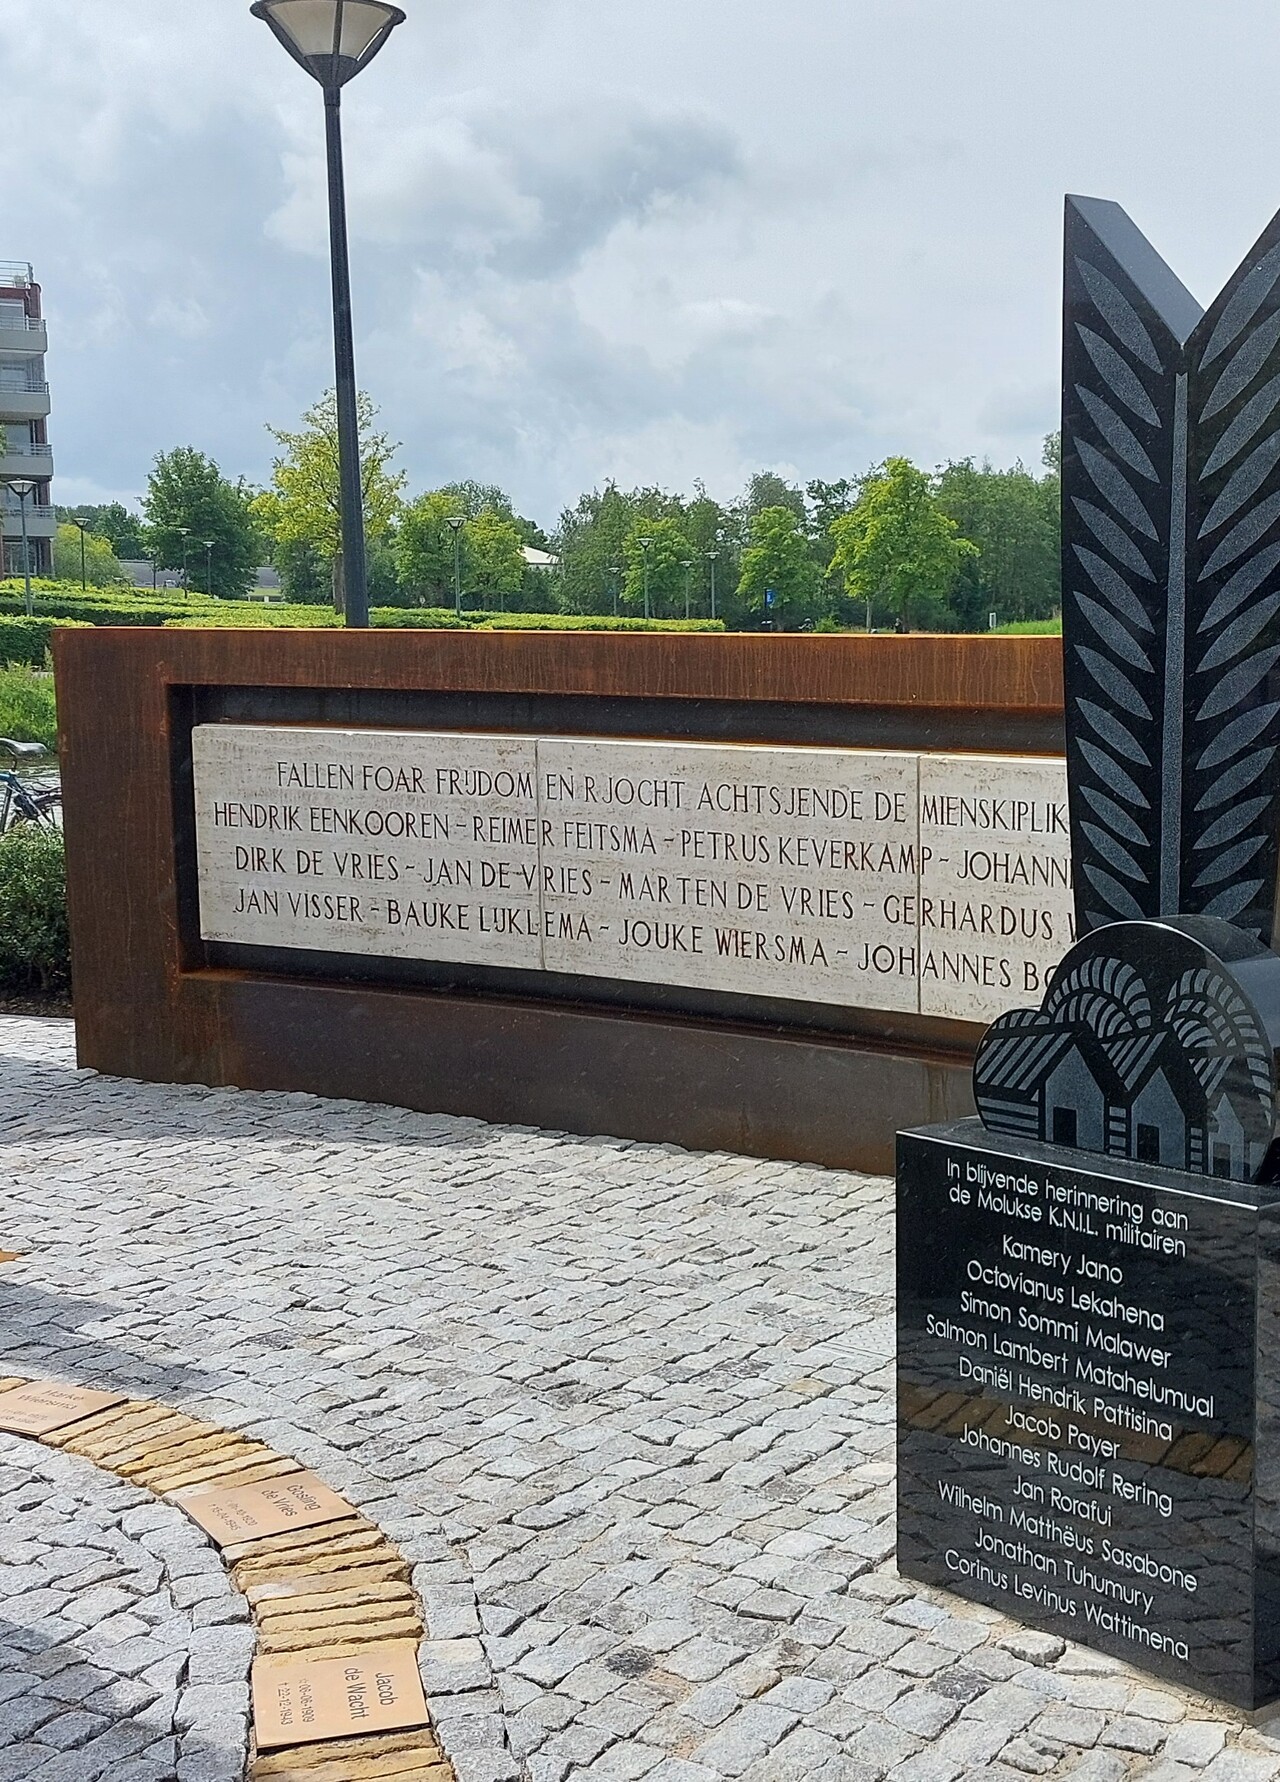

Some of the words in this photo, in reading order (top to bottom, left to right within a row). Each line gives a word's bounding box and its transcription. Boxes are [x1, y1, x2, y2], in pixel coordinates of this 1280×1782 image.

[277, 761, 353, 789] FALLEN
[362, 765, 426, 794] FOAR
[546, 773, 574, 800] EN
[697, 783, 863, 820] ACHTSJENDE
[875, 792, 906, 823] DE
[214, 802, 303, 831] HENDRIK
[310, 807, 449, 840] EENKOOREN
[473, 816, 555, 847] REIMER
[564, 822, 657, 854] FEITSMA
[681, 829, 770, 863] PETRUS
[779, 836, 932, 875] KEVERKAMP
[957, 850, 1073, 889] JOHANN
[235, 845, 288, 873] DIRK
[297, 850, 324, 876] DE
[333, 852, 399, 881] VRIES
[423, 858, 471, 885] JAN
[481, 860, 510, 889] DE
[521, 864, 593, 896] VRIES
[619, 872, 727, 908] MARTEN
[737, 882, 768, 912] DE
[780, 886, 853, 920] VRIES
[884, 894, 1052, 940] GERHARDUS
[235, 888, 279, 917] JAN
[287, 892, 363, 923] VISSER
[387, 900, 470, 931] BAUKE
[619, 919, 703, 953] JOUKE
[714, 928, 829, 967] WIERSMA
[858, 943, 1011, 988] JOHANNES
[947, 1157, 960, 1179] In
[966, 1161, 1039, 1196] blijvende
[1045, 1179, 1144, 1224] herinnering
[1151, 1208, 1189, 1231] aan
[949, 1184, 971, 1205] de
[978, 1193, 1042, 1223] Molukse
[1049, 1205, 1099, 1237] K.N.I.L.
[1106, 1221, 1186, 1258] militairen
[967, 1260, 1064, 1304] Octovianus
[1071, 1285, 1165, 1332] Lekahena
[1003, 1234, 1071, 1275] Kamery
[1076, 1254, 1123, 1284] Jano
[926, 1313, 987, 1351] Salmon
[993, 1332, 1068, 1374] Lambert
[1075, 1357, 1214, 1419] Matahelumual
[960, 1290, 1011, 1324] Simon
[1018, 1307, 1079, 1343] Sommi
[1086, 1325, 1172, 1369] Malawer
[959, 1355, 1013, 1392] Daniël
[1019, 1373, 1087, 1416] Hendrik
[1094, 1397, 1173, 1442] Pattisina
[1004, 1405, 1061, 1440] Jacob
[1068, 1423, 1120, 1460] Payer
[959, 1423, 1040, 1467] Johannes
[1047, 1451, 1105, 1491] Rudolf
[1113, 1473, 1173, 1517] Rering
[1013, 1475, 1044, 1504] Jan
[273, 1498, 298, 1517] Vries
[938, 1480, 1003, 1522] Wilhelm
[1009, 1508, 1094, 1555] Matthëus
[1101, 1539, 1197, 1592] Sasabone
[945, 1549, 1008, 1590] Corinus
[1014, 1574, 1077, 1617] Levinus
[1083, 1600, 1189, 1661] Wattimena
[974, 1528, 1057, 1576] Jonathan
[1063, 1559, 1153, 1615] Tuhumury
[344, 1667, 364, 1682] de
[346, 1682, 370, 1720] Wacht
[375, 1672, 398, 1706] Jacob
